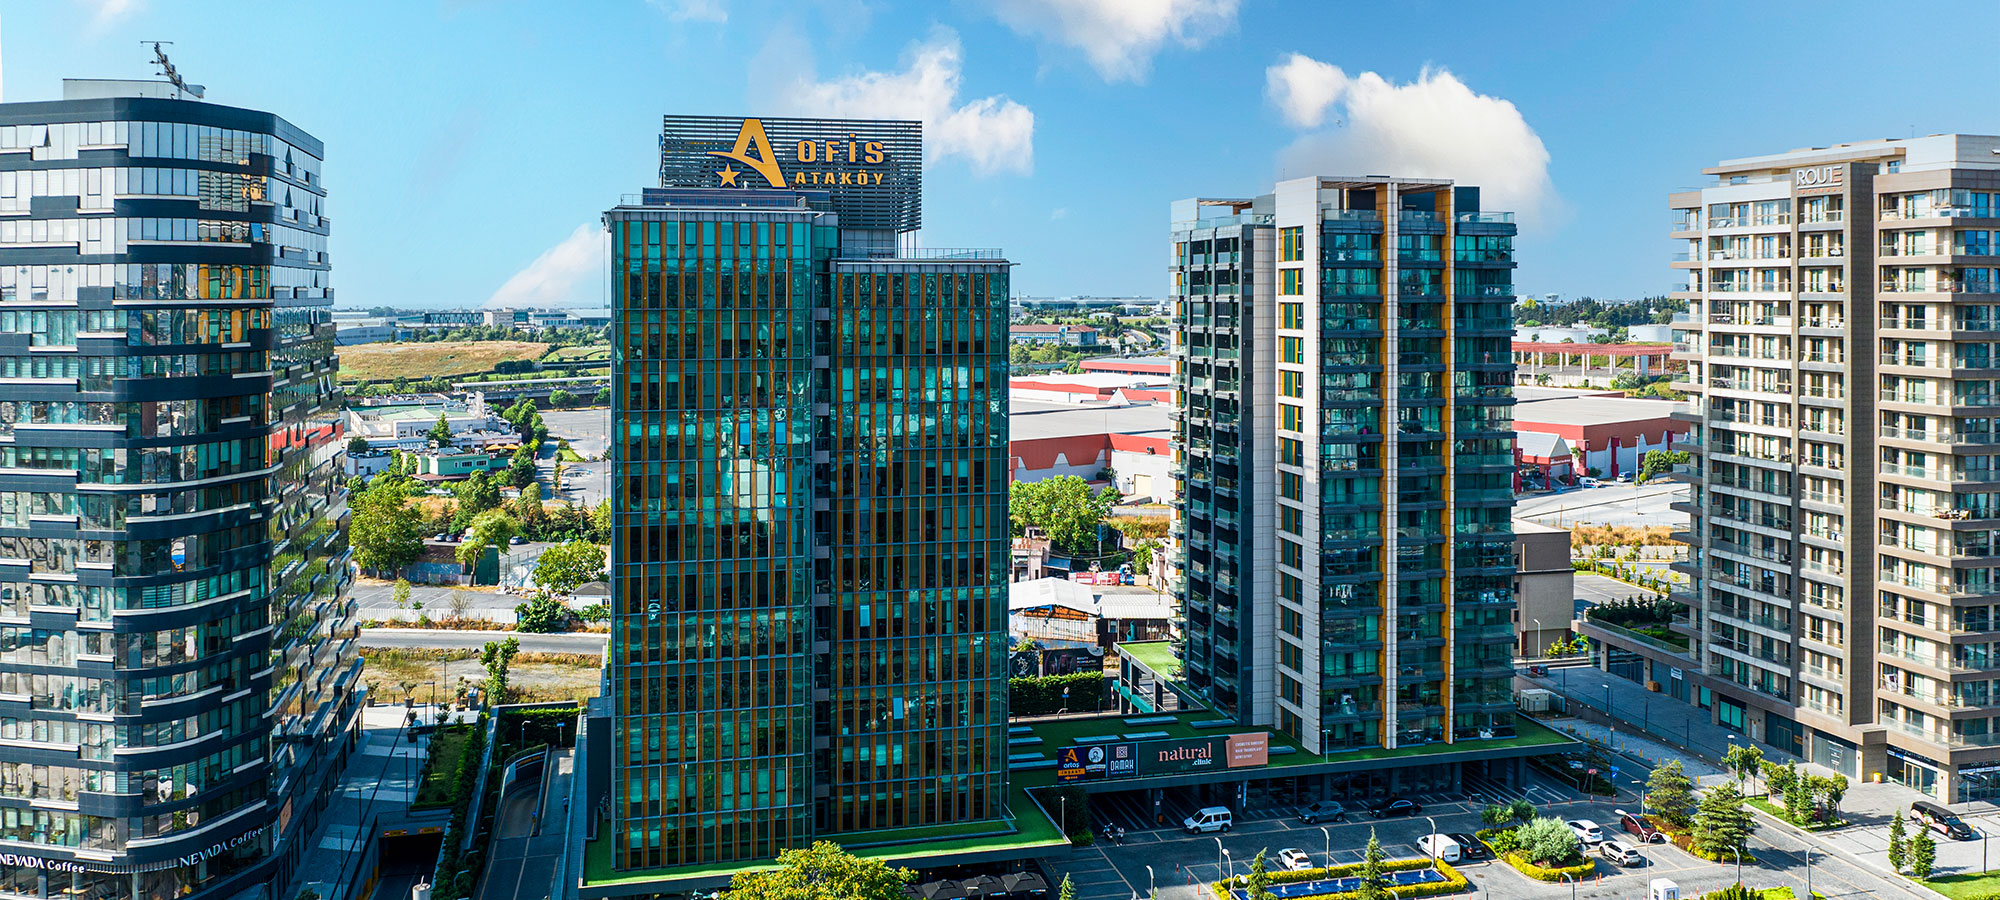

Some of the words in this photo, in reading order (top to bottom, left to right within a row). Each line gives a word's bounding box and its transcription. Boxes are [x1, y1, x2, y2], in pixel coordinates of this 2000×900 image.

[797, 133, 884, 163] OFİS
[795, 169, 883, 185] ATAKÖY
[1796, 166, 1843, 185] ROUTE
[1158, 742, 1212, 762] natural
[179, 840, 228, 869] NEVADA
[230, 828, 263, 848] Coffee
[0, 853, 45, 869] NEVADA
[47, 860, 85, 873] Coffee
